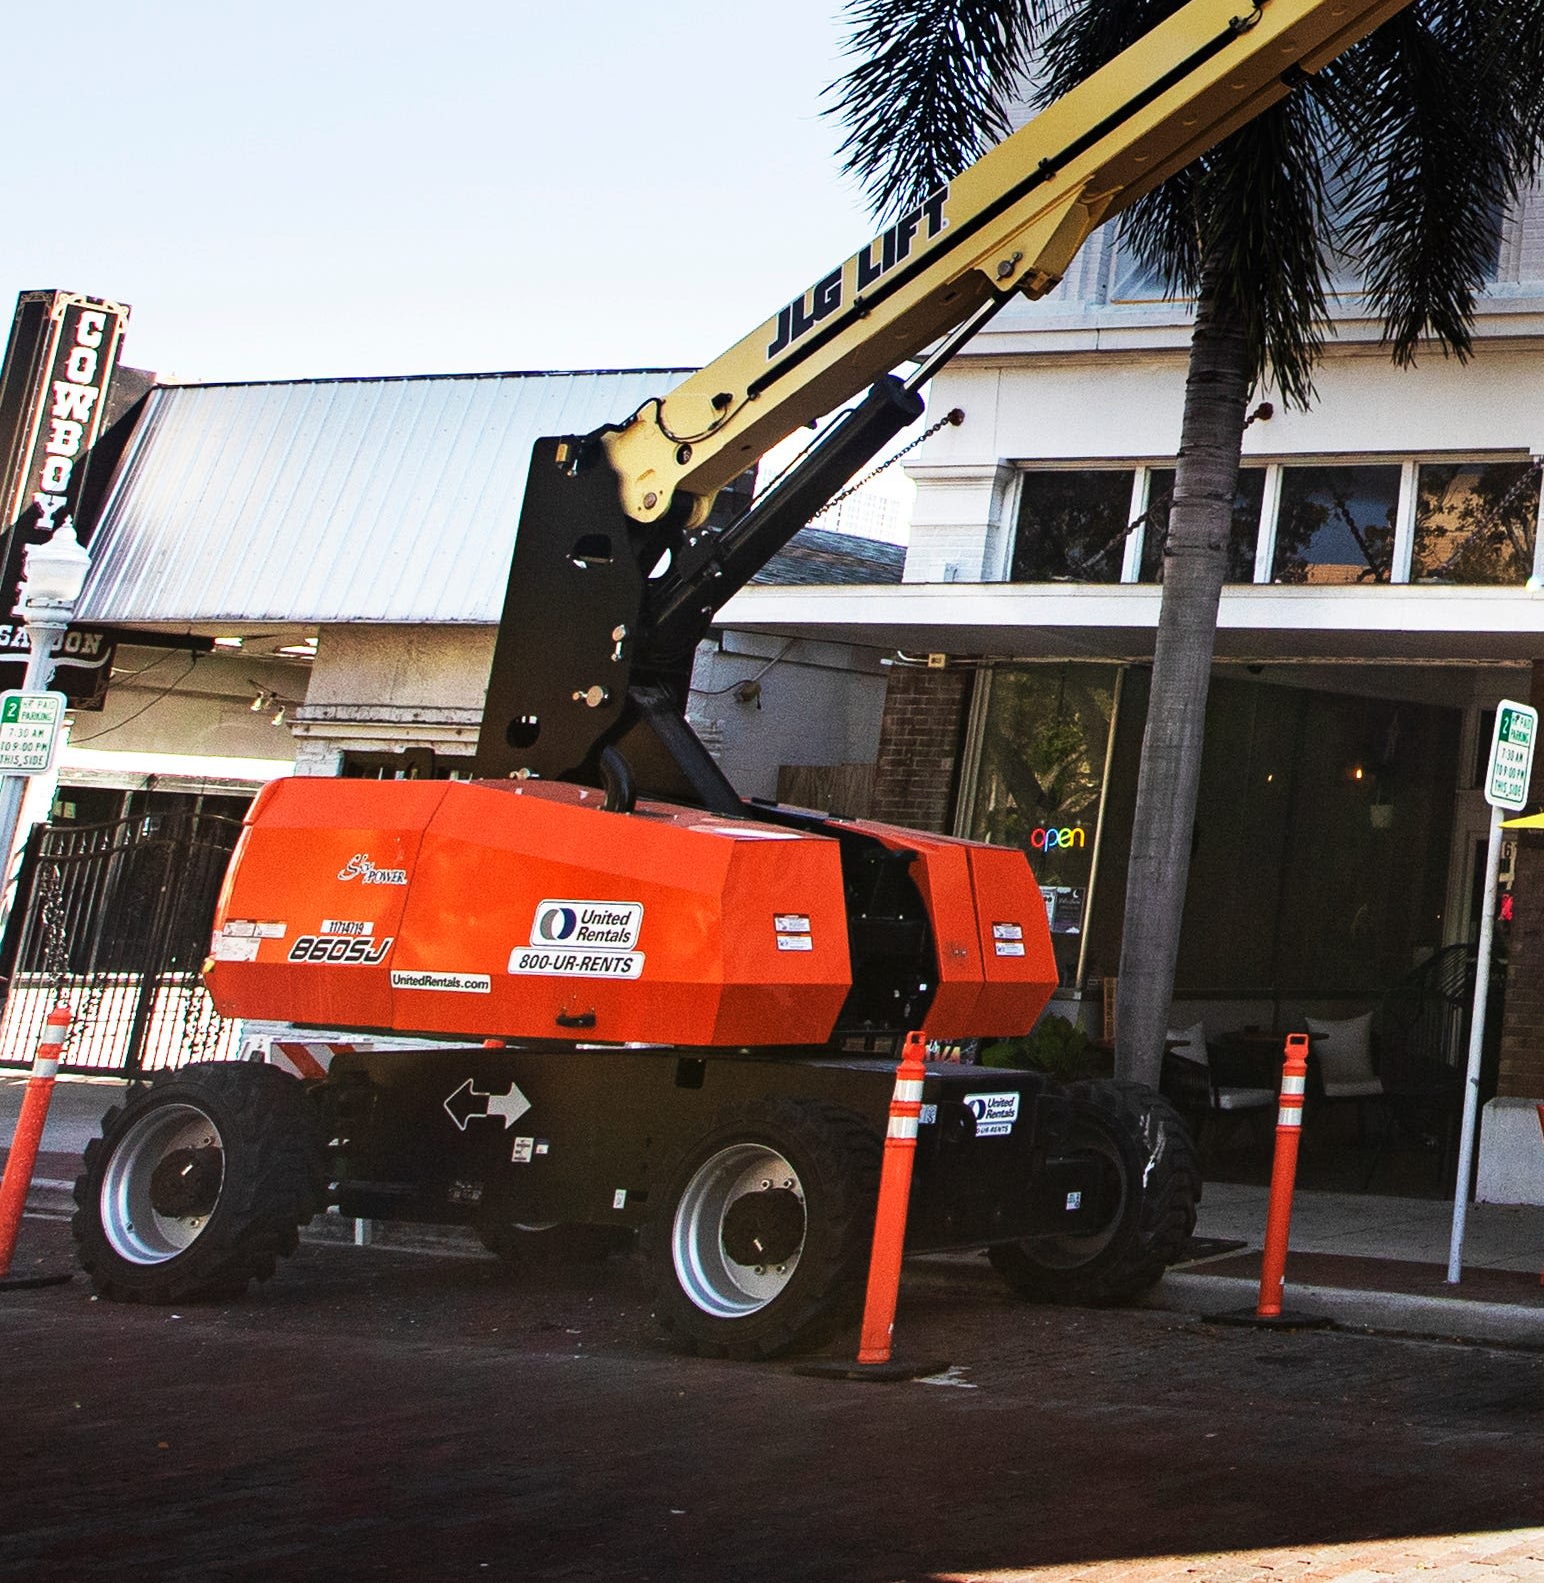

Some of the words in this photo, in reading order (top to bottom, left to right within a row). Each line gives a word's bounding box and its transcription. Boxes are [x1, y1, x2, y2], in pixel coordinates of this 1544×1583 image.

[767, 265, 843, 360] JLG
[857, 186, 949, 293] LIFT
[33, 310, 106, 530] COWBOY
[0, 624, 103, 655] SAOON
[7, 702, 17, 718] 2
[38, 698, 56, 710] PAID
[21, 711, 54, 721] PARKING
[32, 728, 45, 738] AM
[1502, 717, 1510, 734] 2
[1511, 728, 1529, 744] PARKING
[35, 742, 48, 752] PM
[0, 754, 19, 766] THIS
[23, 755, 43, 766] SIDE
[1515, 752, 1524, 763] AM
[1496, 763, 1503, 775] TO
[1517, 768, 1525, 780] PM
[1495, 779, 1507, 793] THIS
[1508, 783, 1522, 797] SIDE
[1030, 828, 1085, 852] open
[365, 869, 407, 885] POWER
[581, 909, 632, 926] United
[576, 926, 632, 943] Rentals
[289, 936, 393, 964] 860SJ
[519, 953, 633, 973] 800-UR-RENTS
[391, 973, 489, 990] UnitedRentals.com
[987, 1096, 1015, 1109] United
[985, 1107, 1016, 1120] Rentals
